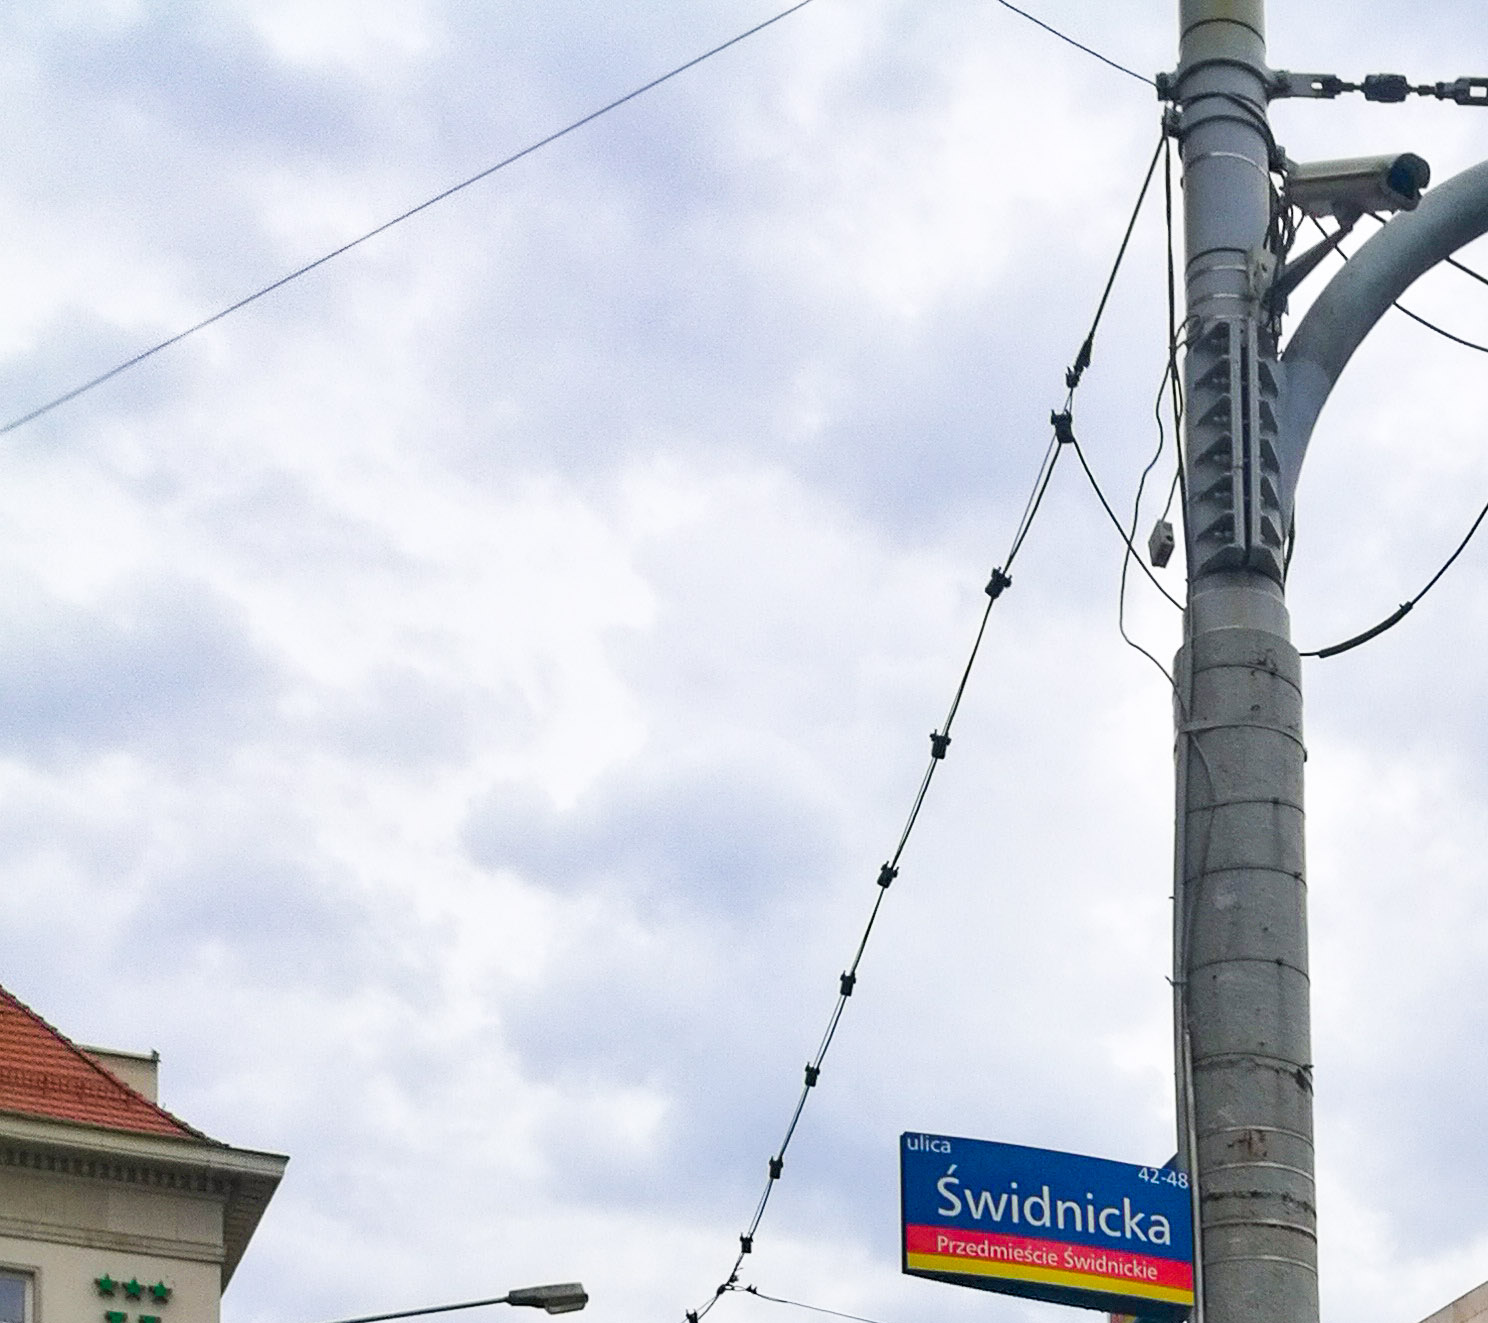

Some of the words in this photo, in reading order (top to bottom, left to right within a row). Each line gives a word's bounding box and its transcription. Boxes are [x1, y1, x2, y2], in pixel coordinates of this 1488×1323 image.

[907, 1134, 951, 1154] ulica
[1138, 1167, 1189, 1189] 42-48
[937, 1164, 1171, 1246] Świdnicka
[937, 1235, 1058, 1267] Przedmieście
[1063, 1246, 1158, 1280] Świdnickie
